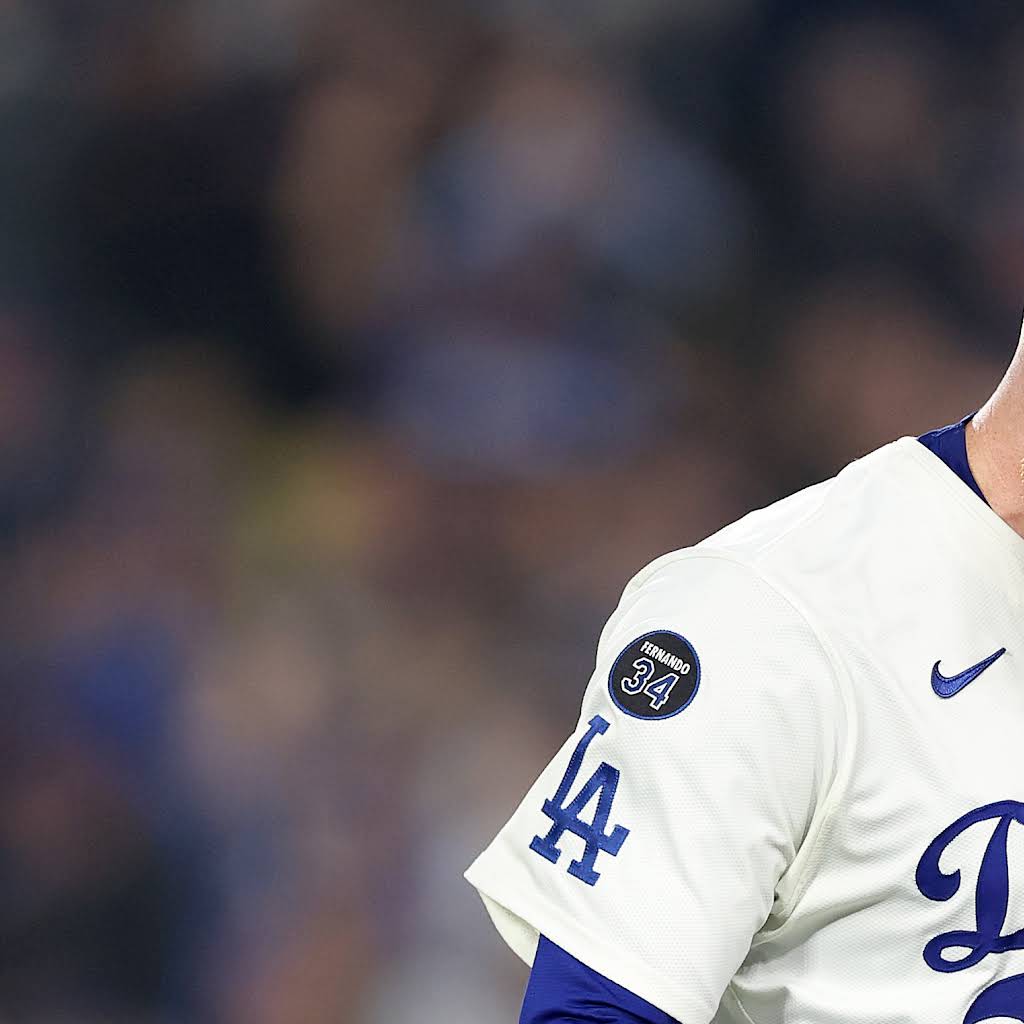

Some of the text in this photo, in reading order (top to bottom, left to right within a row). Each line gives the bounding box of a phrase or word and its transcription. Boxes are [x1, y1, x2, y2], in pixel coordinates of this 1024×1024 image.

[621, 657, 680, 710] 34
[640, 641, 691, 675] FERNANDO
[529, 715, 630, 886] LA
